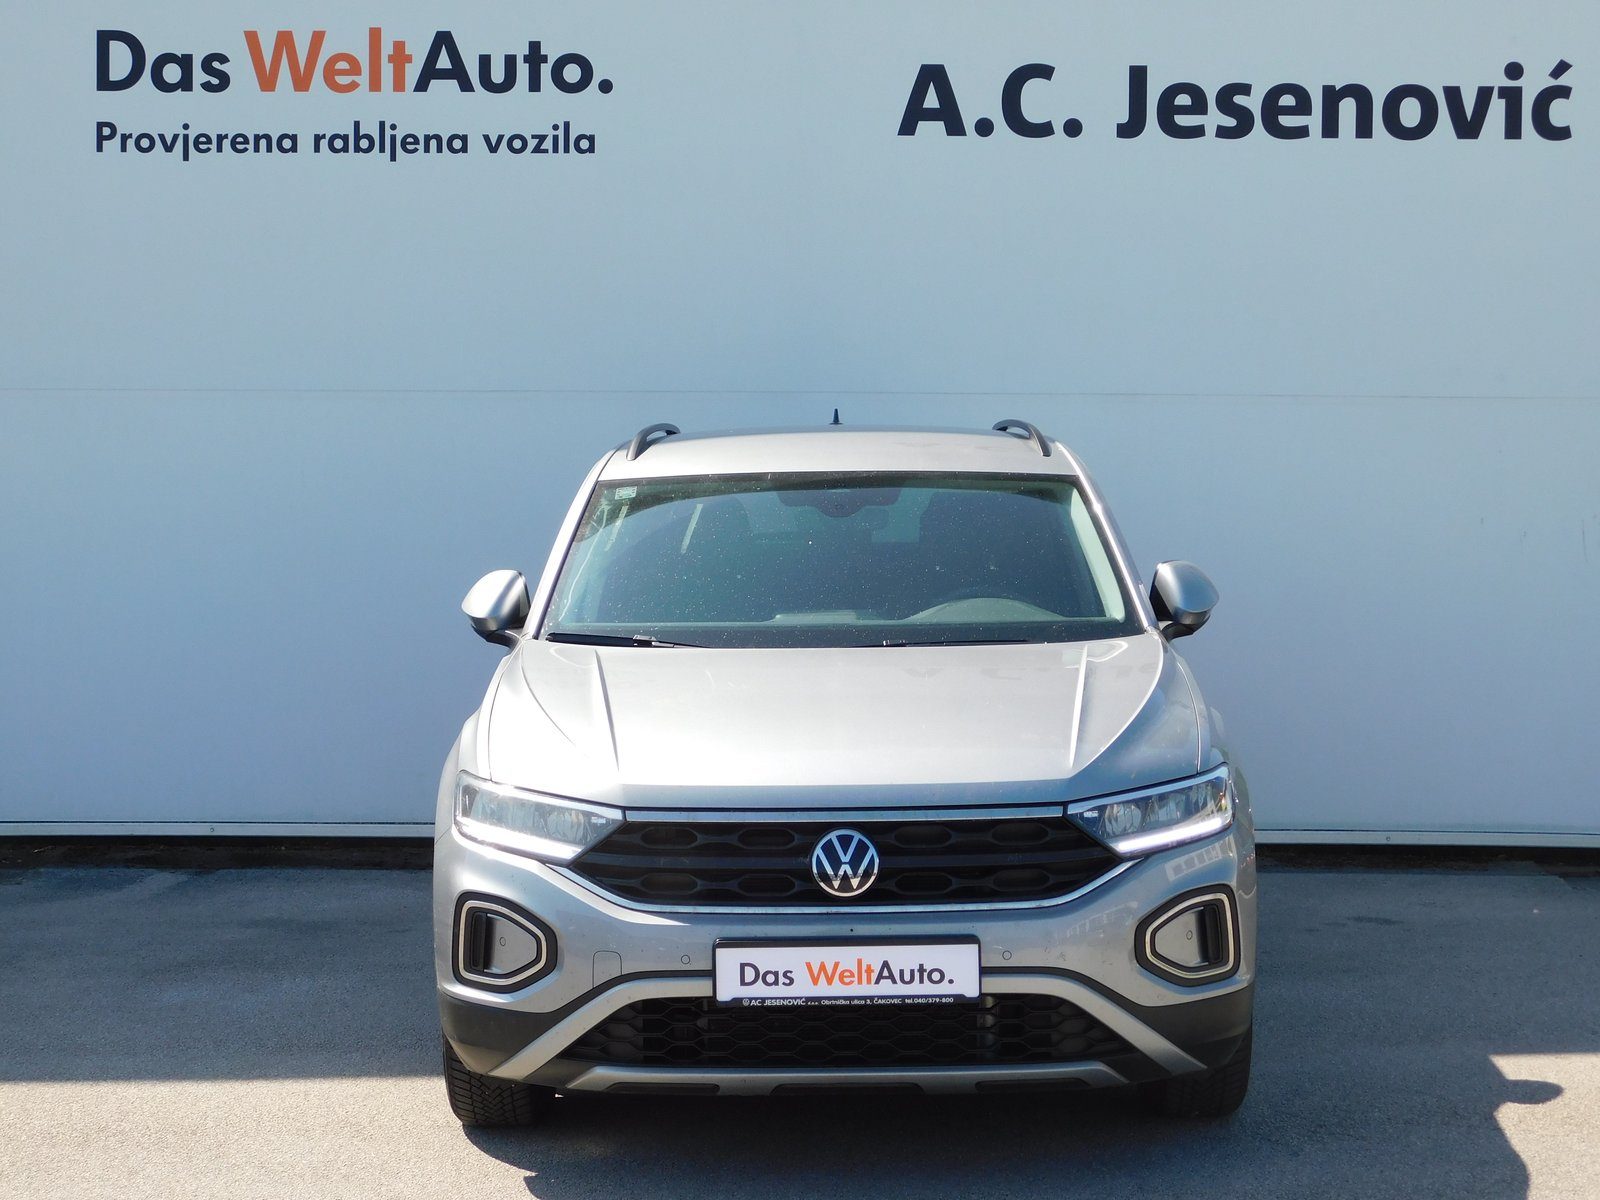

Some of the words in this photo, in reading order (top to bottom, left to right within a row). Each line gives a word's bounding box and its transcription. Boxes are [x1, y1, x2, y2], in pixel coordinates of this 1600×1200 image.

[96, 29, 230, 94] Das
[243, 27, 614, 94] WeltAuto.
[897, 63, 1083, 138] A.C.
[1116, 58, 1573, 141] Jesenović
[96, 121, 299, 162] Provjerena
[313, 121, 468, 162] rabljena
[482, 121, 597, 154] vozila
[739, 962, 795, 987] Das
[805, 958, 955, 987] WeltAuto.
[763, 998, 806, 1006] JESENOVIĆ
[873, 997, 902, 1005] ČAKOVEC
